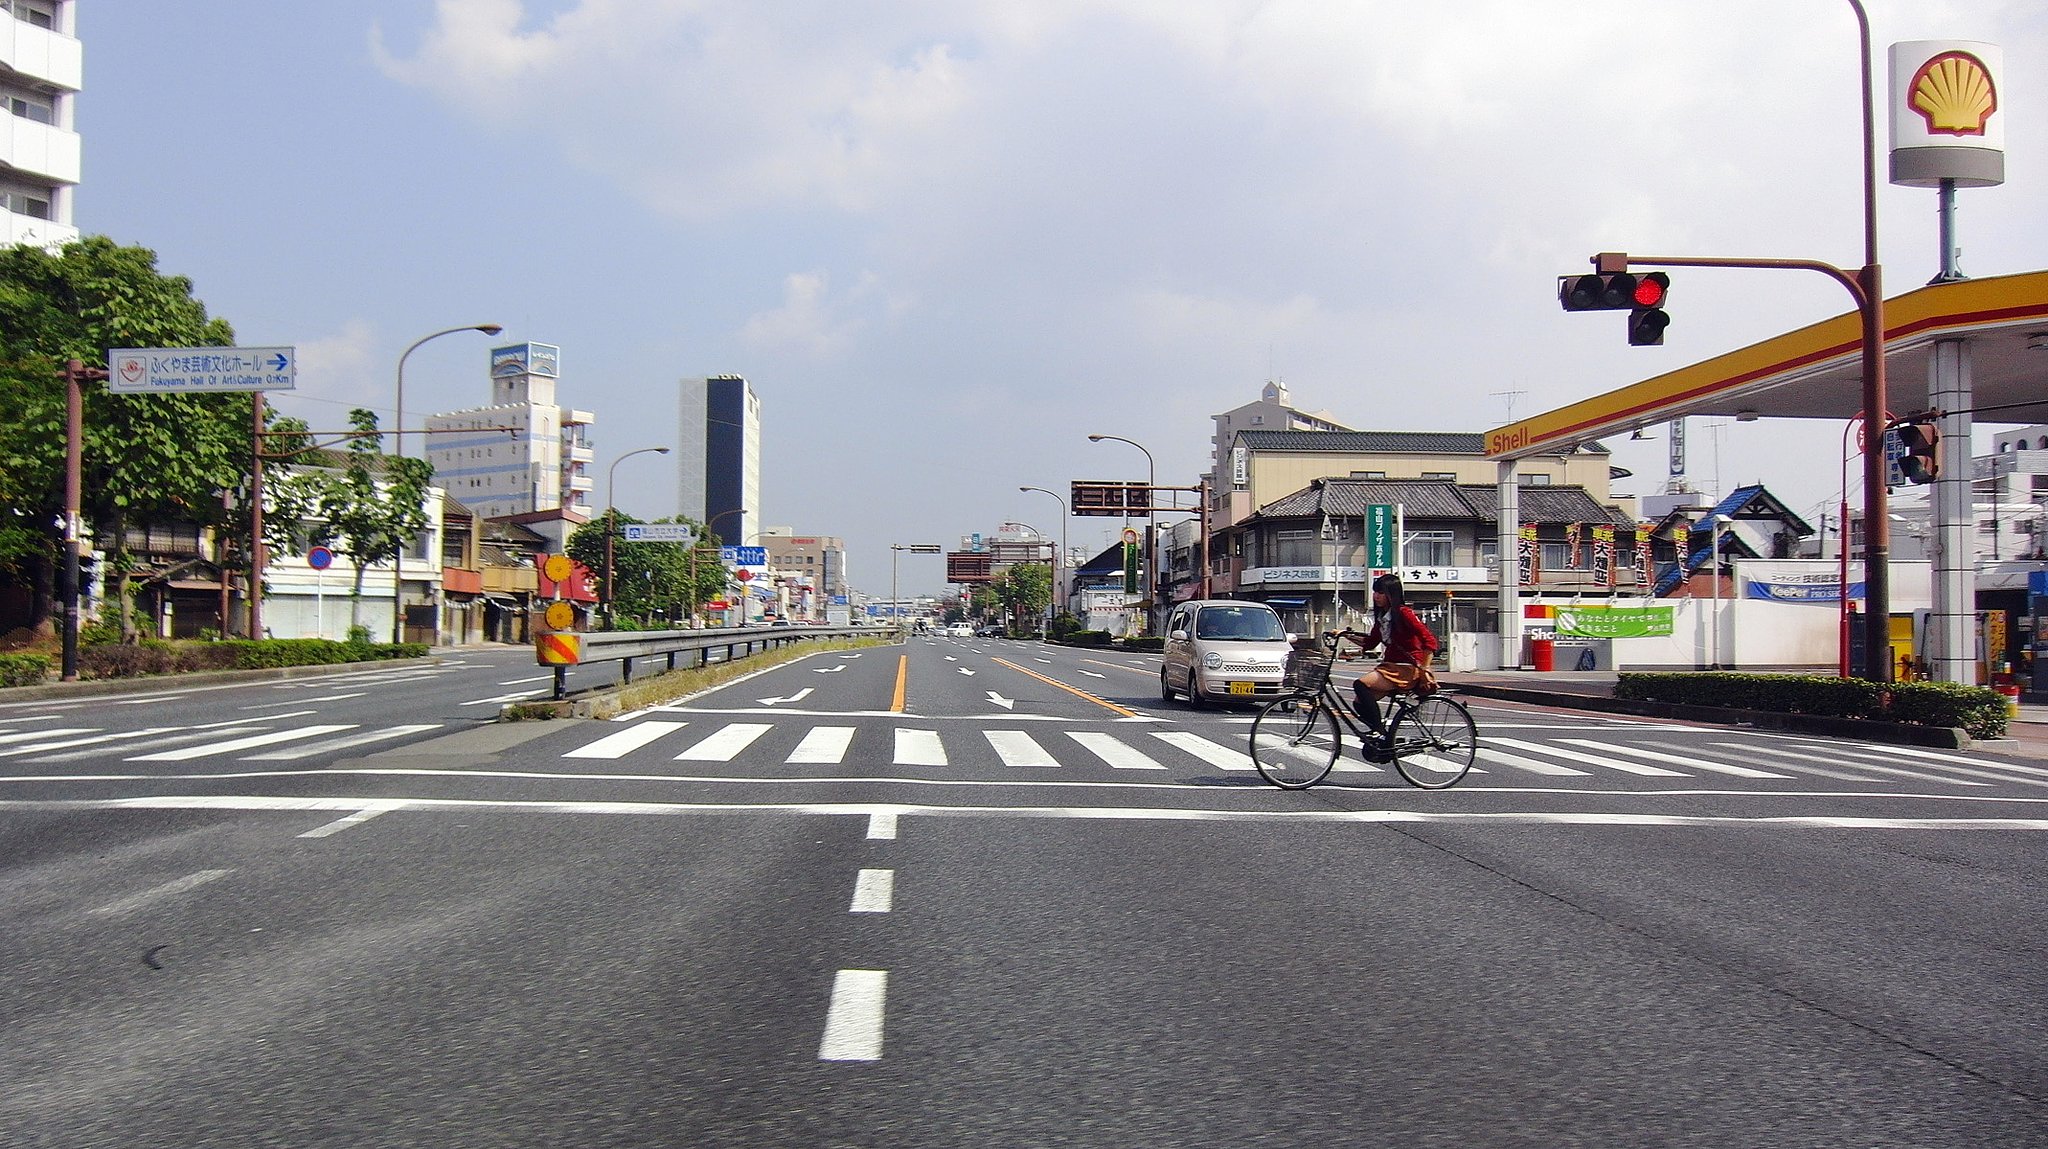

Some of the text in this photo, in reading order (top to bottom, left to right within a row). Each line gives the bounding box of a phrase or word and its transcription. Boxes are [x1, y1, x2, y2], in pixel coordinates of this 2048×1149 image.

[151, 355, 262, 373] ふくやま芸術文化ホール
[151, 376, 186, 387] Fukuyama
[191, 375, 204, 385] Hall
[209, 374, 217, 385] Of
[1493, 426, 1528, 454] Shell
[1375, 507, 1384, 567] 福山プラザホテル
[1263, 569, 1320, 580] ビジネス旅館
